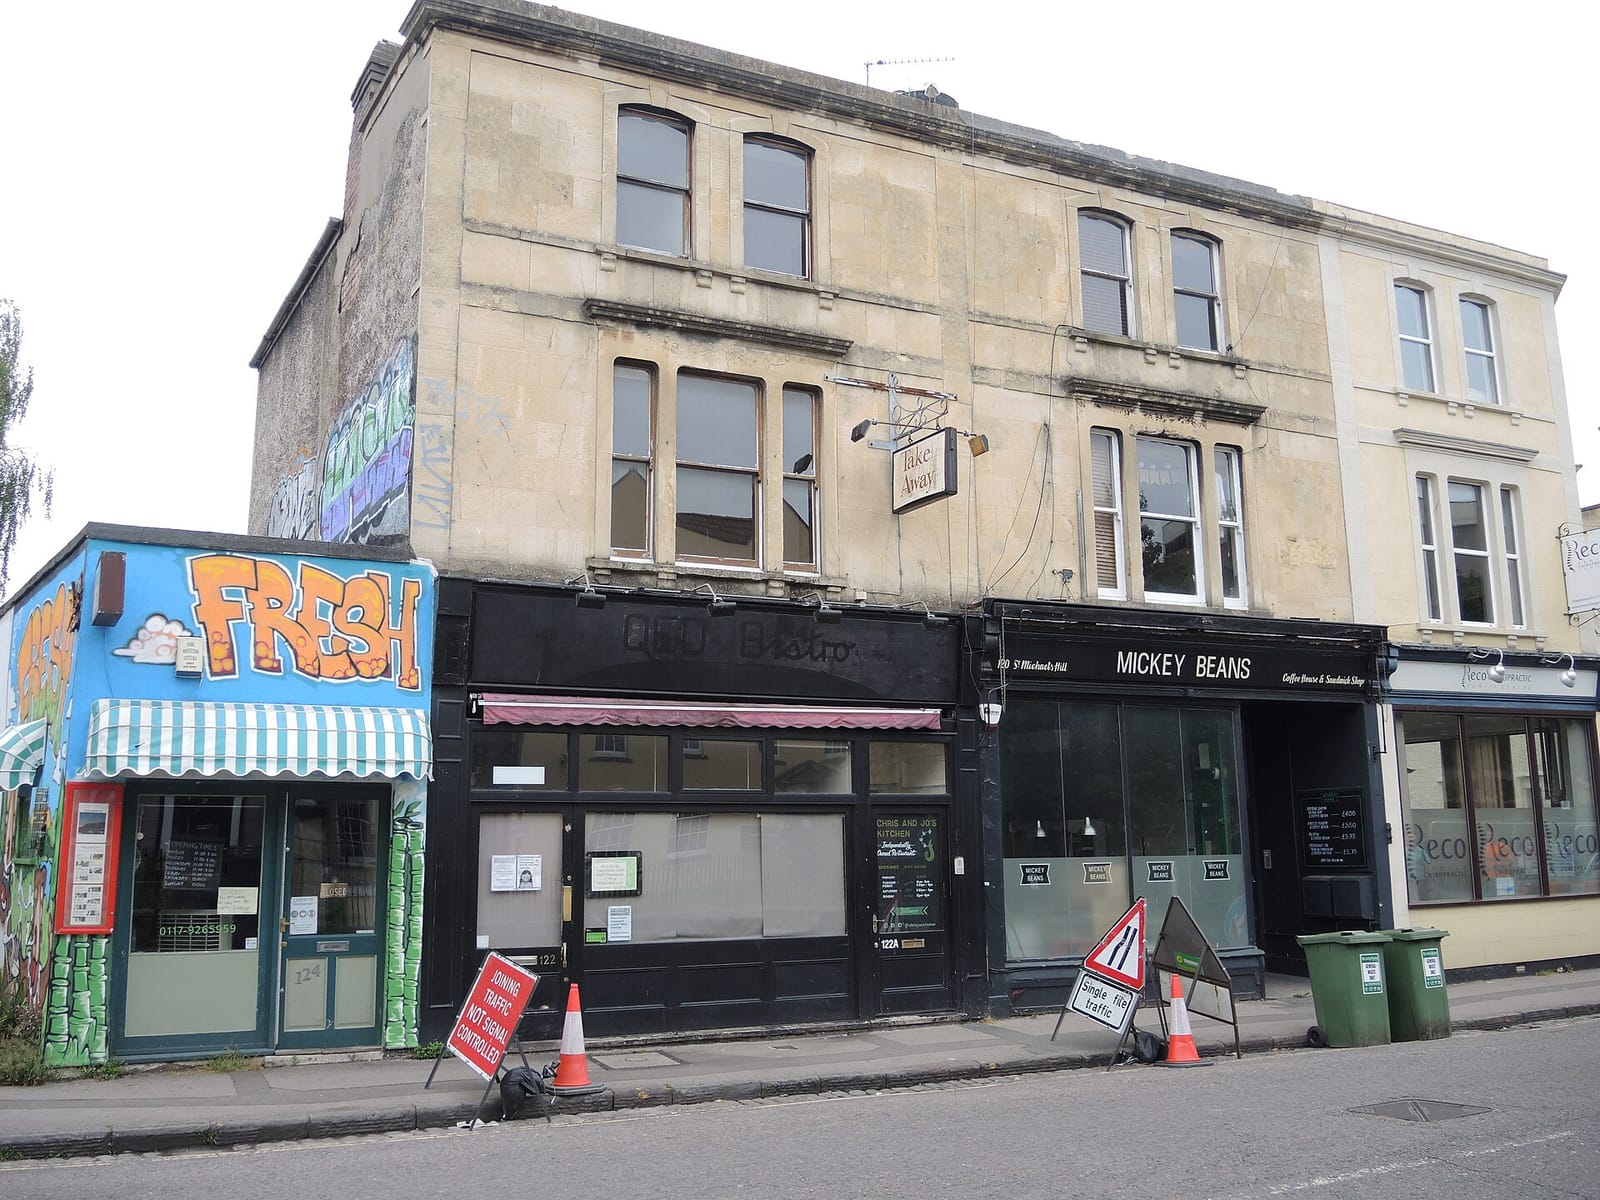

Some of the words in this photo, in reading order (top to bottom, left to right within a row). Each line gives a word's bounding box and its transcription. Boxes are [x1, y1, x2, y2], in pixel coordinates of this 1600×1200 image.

[901, 446, 931, 472] Take
[900, 470, 936, 497] Away
[188, 553, 421, 691] FRESH
[624, 614, 705, 661] QED
[742, 622, 858, 662] Bistro
[997, 659, 1010, 669] 120
[1054, 662, 1068, 672] Hill
[1116, 651, 1186, 676] MICKEY
[1196, 655, 1251, 679] BEANS
[1462, 665, 1487, 686] Reco
[1282, 672, 1300, 684] Coffee
[1301, 674, 1318, 684] House
[1319, 674, 1324, 684] &
[1325, 674, 1350, 684] Sandwich
[1351, 676, 1364, 687] Shop
[877, 819, 898, 827] CHRIS
[902, 819, 917, 827] AND
[921, 819, 937, 827] JO'S
[877, 830, 910, 838] KITCHEN
[1406, 824, 1466, 872] Reco
[1477, 823, 1535, 870] Reco
[1544, 821, 1597, 868] Reco
[160, 924, 236, 936] 0117-9265959
[881, 939, 899, 949] 122A
[540, 954, 556, 965] 122
[295, 964, 320, 985] 124
[490, 969, 521, 997] JOINING
[484, 988, 512, 1016] TRAFFIC
[1082, 980, 1108, 1000] Single
[1113, 994, 1128, 1009] file
[1086, 998, 1112, 1018] traffic
[466, 1003, 487, 1026] NOT
[482, 1016, 508, 1045] SIGNAL
[457, 1024, 500, 1065] CONTROLLED
